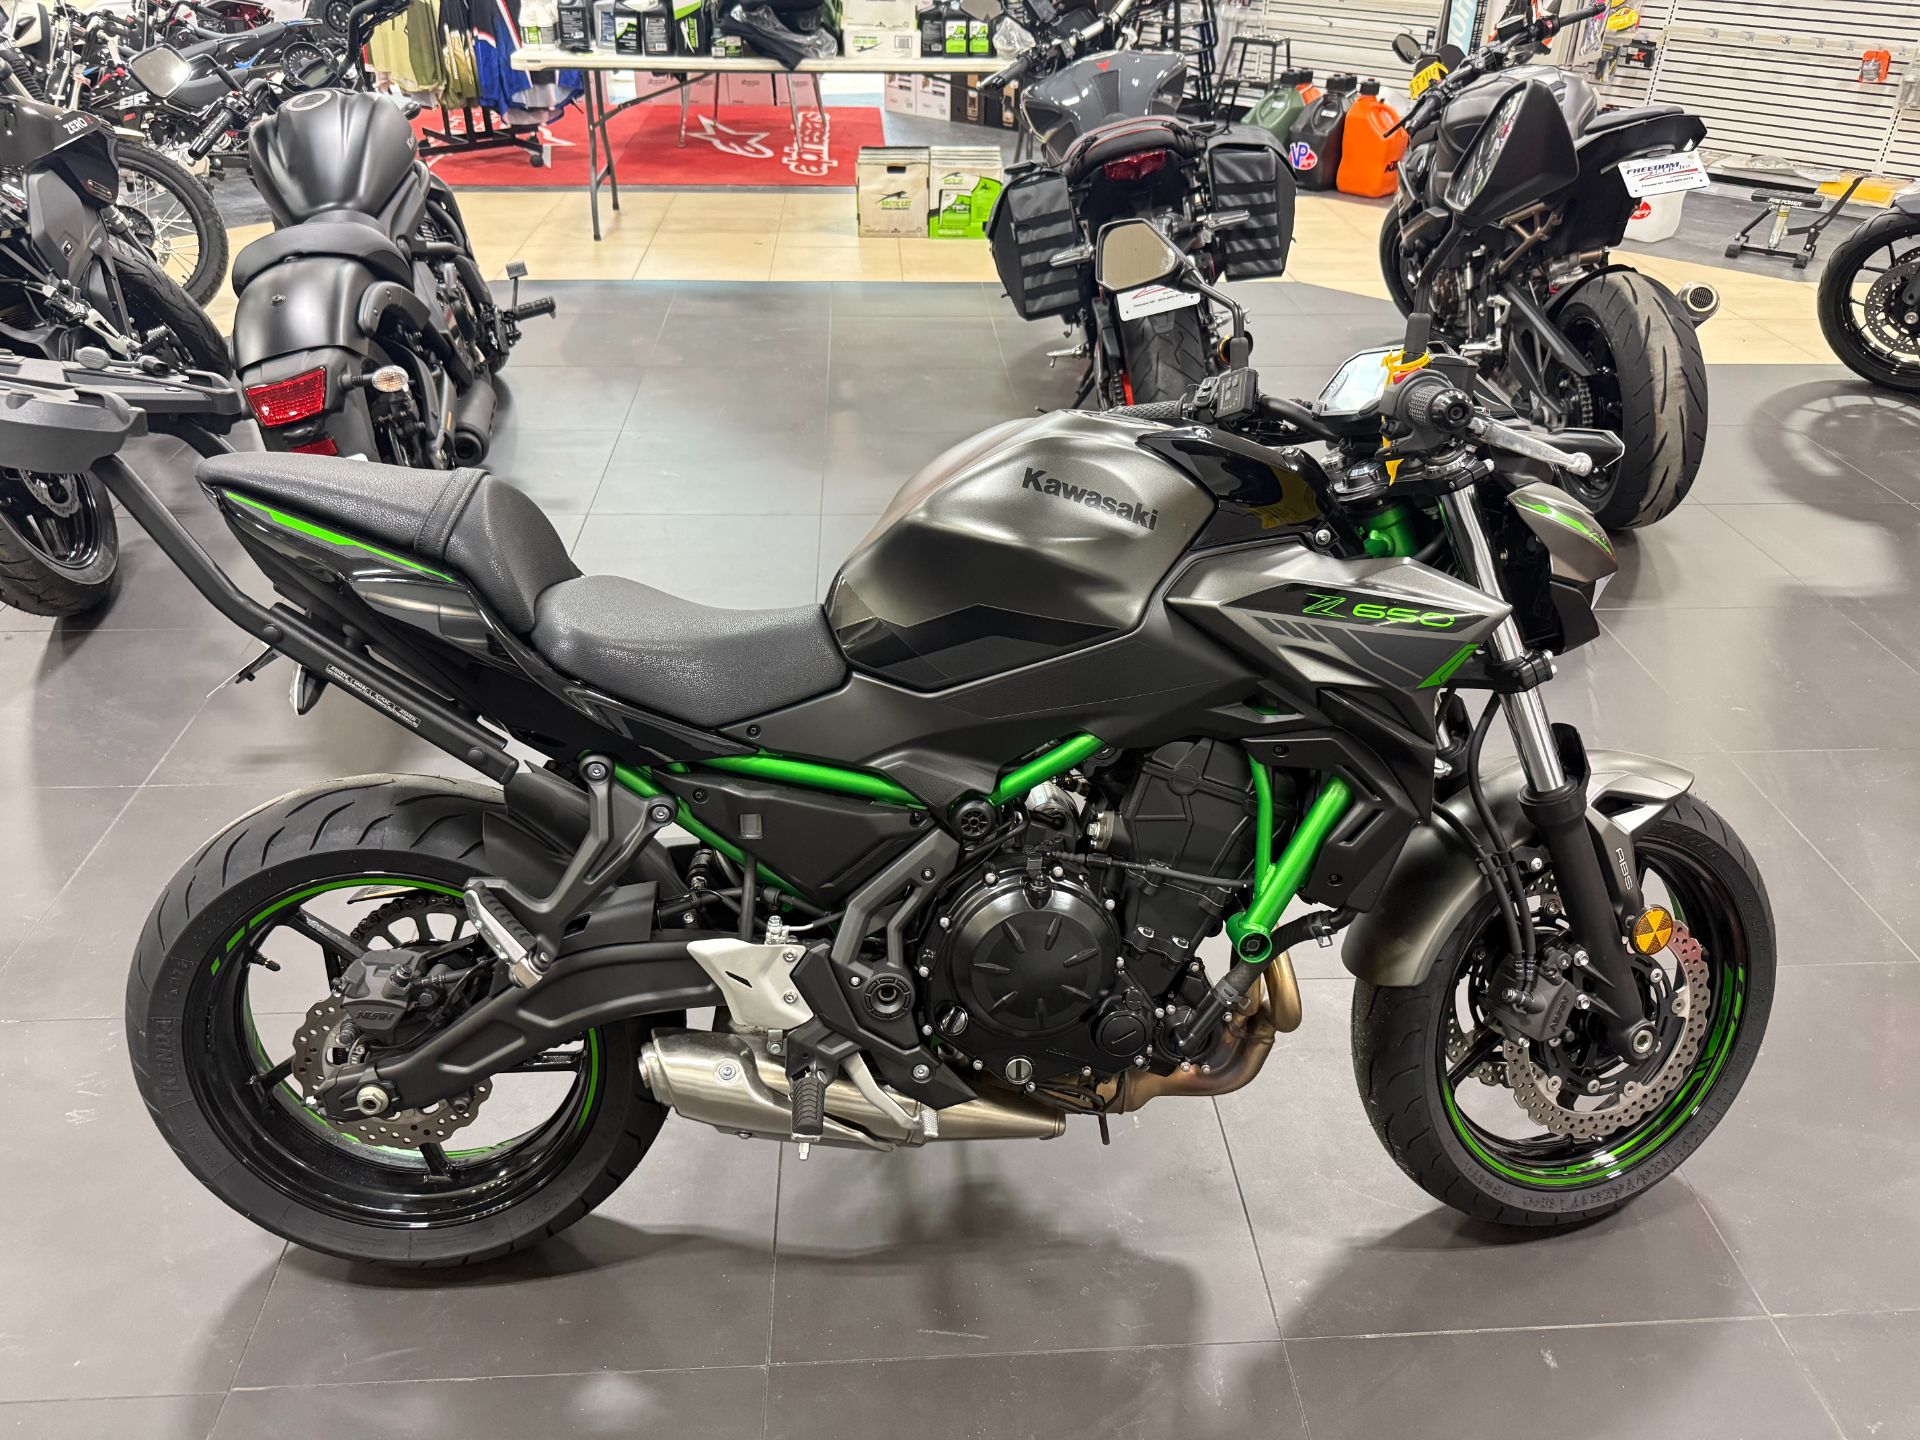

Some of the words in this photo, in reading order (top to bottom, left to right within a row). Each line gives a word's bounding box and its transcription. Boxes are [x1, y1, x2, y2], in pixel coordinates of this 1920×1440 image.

[63, 118, 89, 135] ZERO
[1290, 142, 1309, 168] VP
[1022, 467, 1158, 531] Kawasaki
[1616, 847, 1632, 890] ABS
